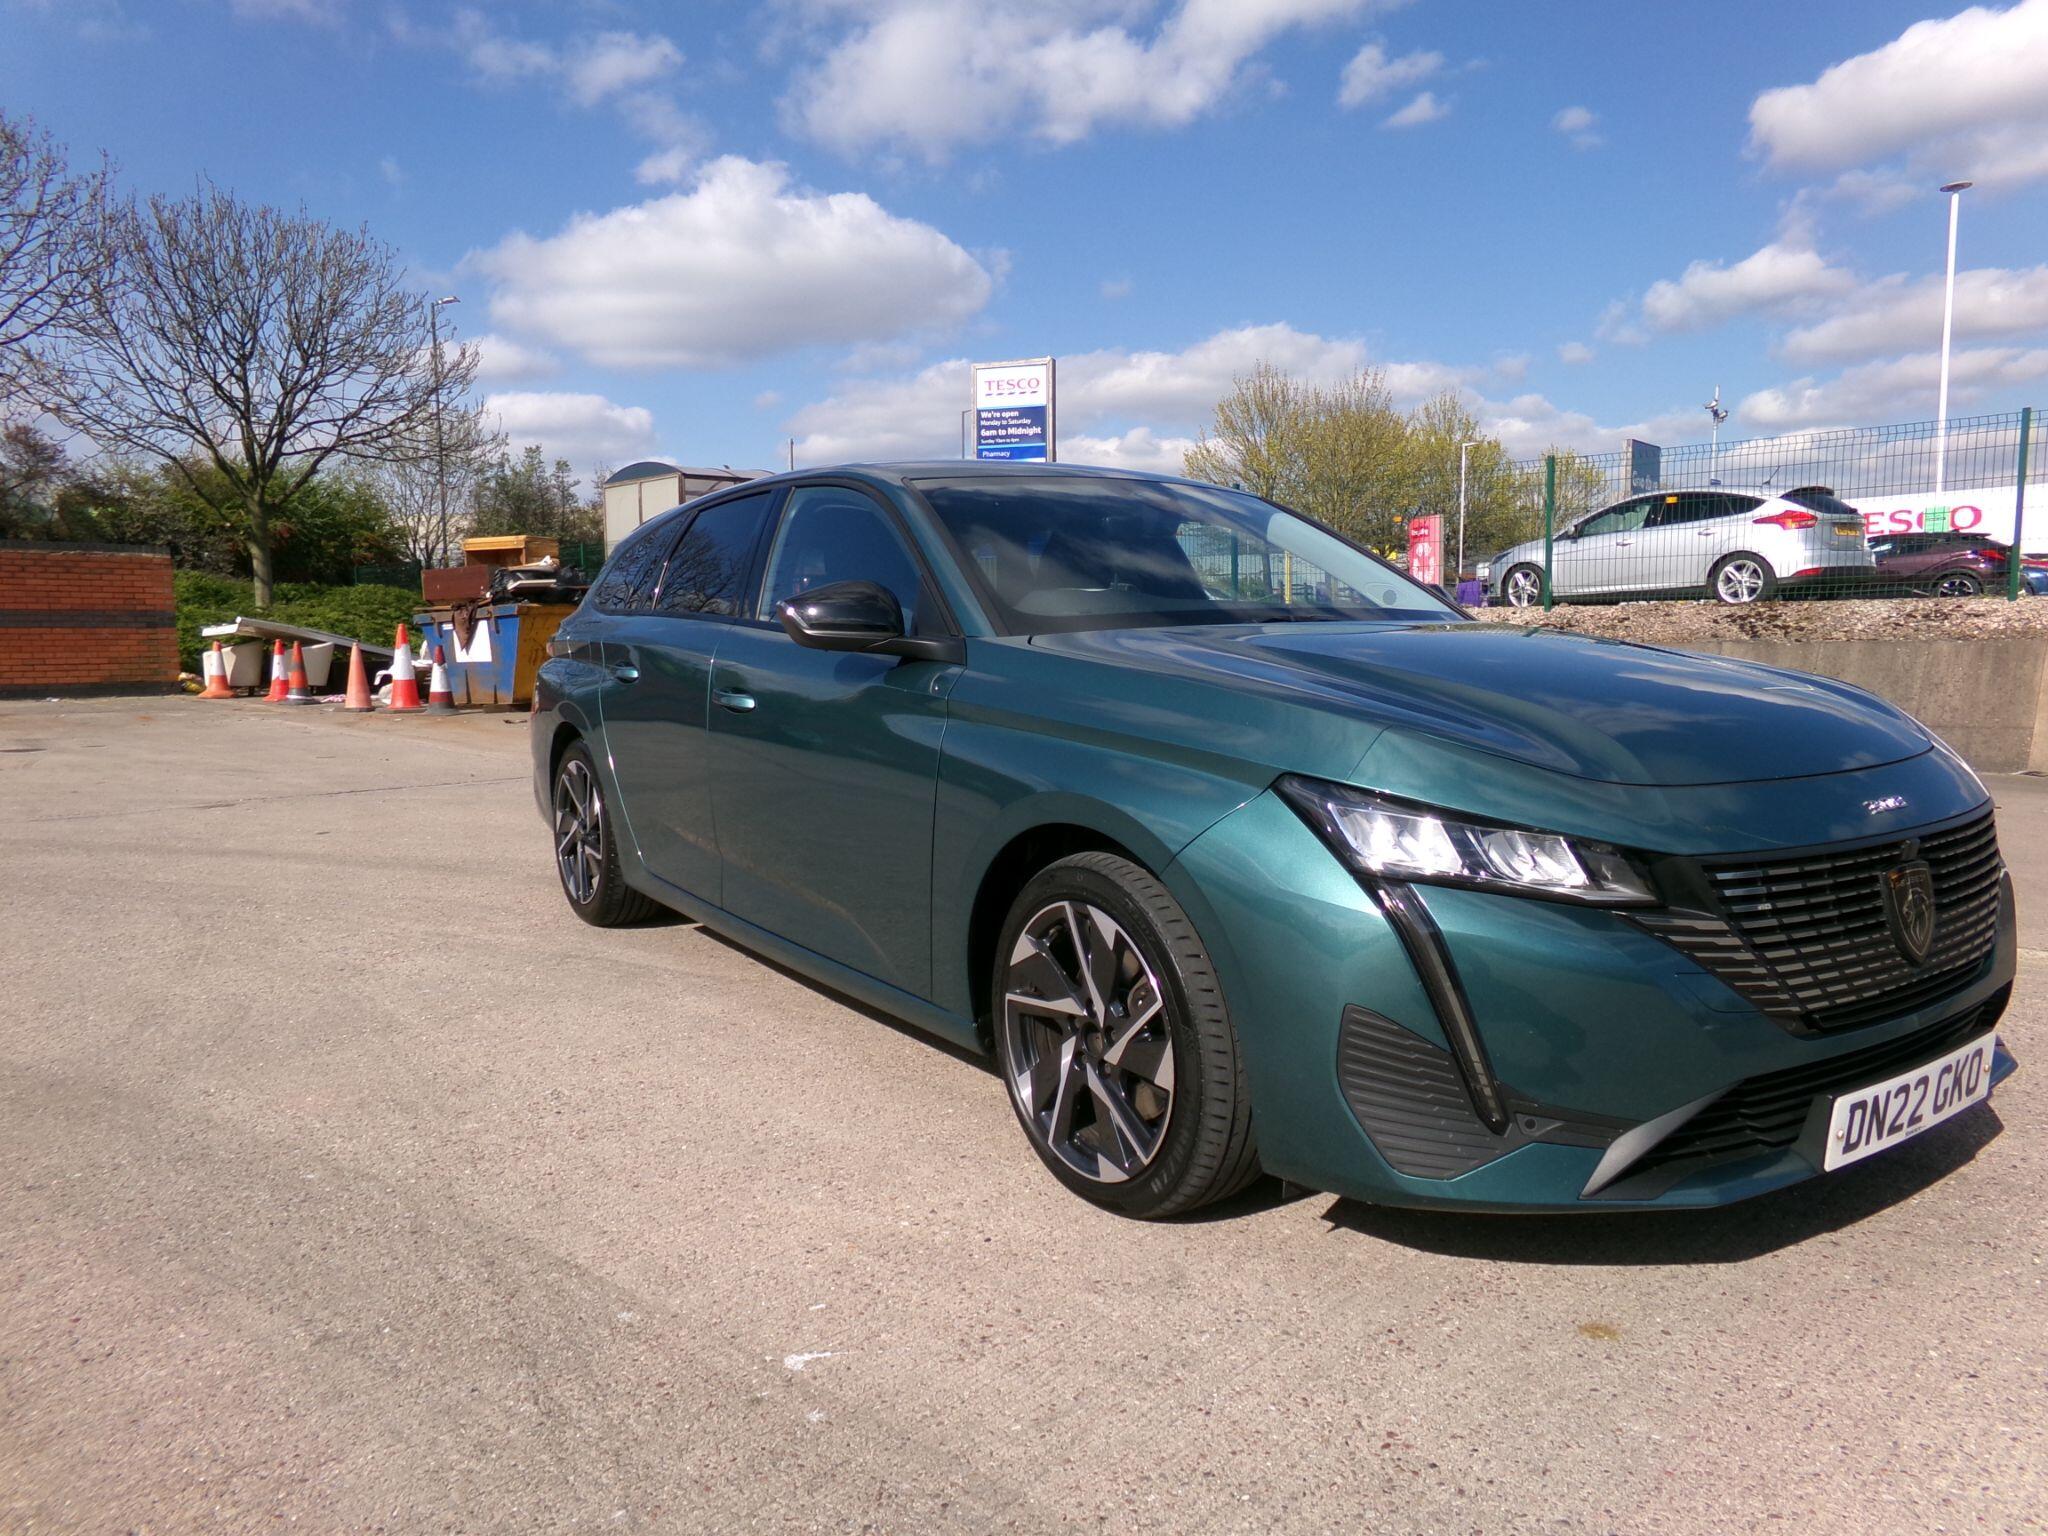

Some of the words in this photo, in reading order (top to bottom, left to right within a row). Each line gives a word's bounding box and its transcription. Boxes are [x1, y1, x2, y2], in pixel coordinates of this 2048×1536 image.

[984, 377, 1040, 391] TESCO
[1008, 426, 1041, 436] Midnight
[1842, 1075, 1930, 1155] DN22
[1932, 1047, 1984, 1115] GKO
